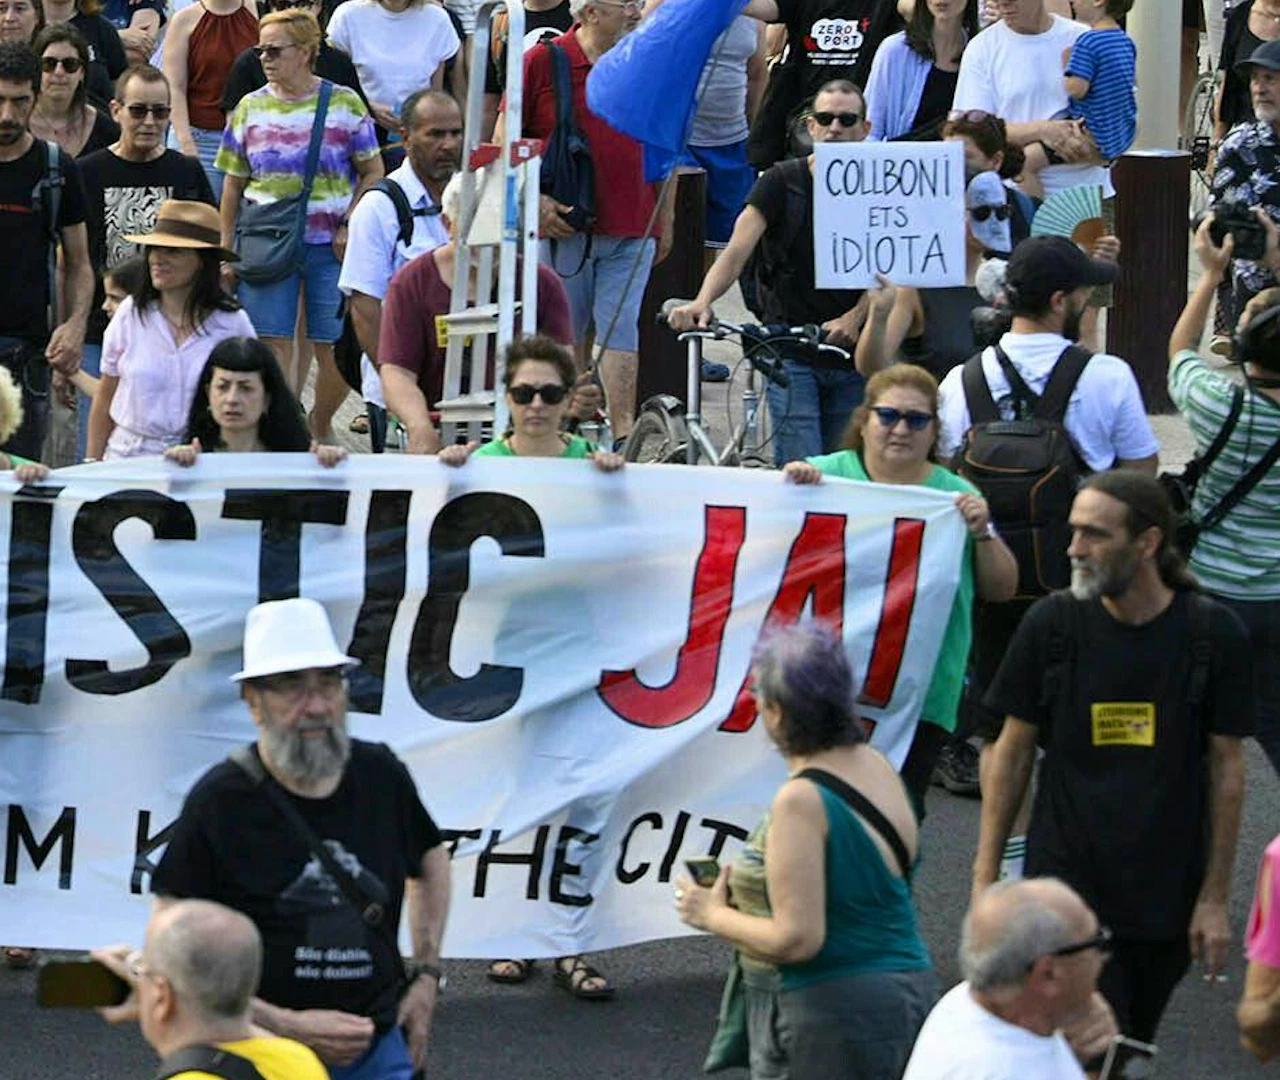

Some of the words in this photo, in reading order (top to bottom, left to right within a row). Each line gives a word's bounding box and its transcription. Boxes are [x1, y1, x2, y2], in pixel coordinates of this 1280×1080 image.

[817, 23, 852, 36] ZERO
[825, 152, 951, 198] COLLBONI
[868, 205, 909, 228] ETS
[832, 230, 948, 275] IDIOTA
[614, 809, 750, 885] CIT
